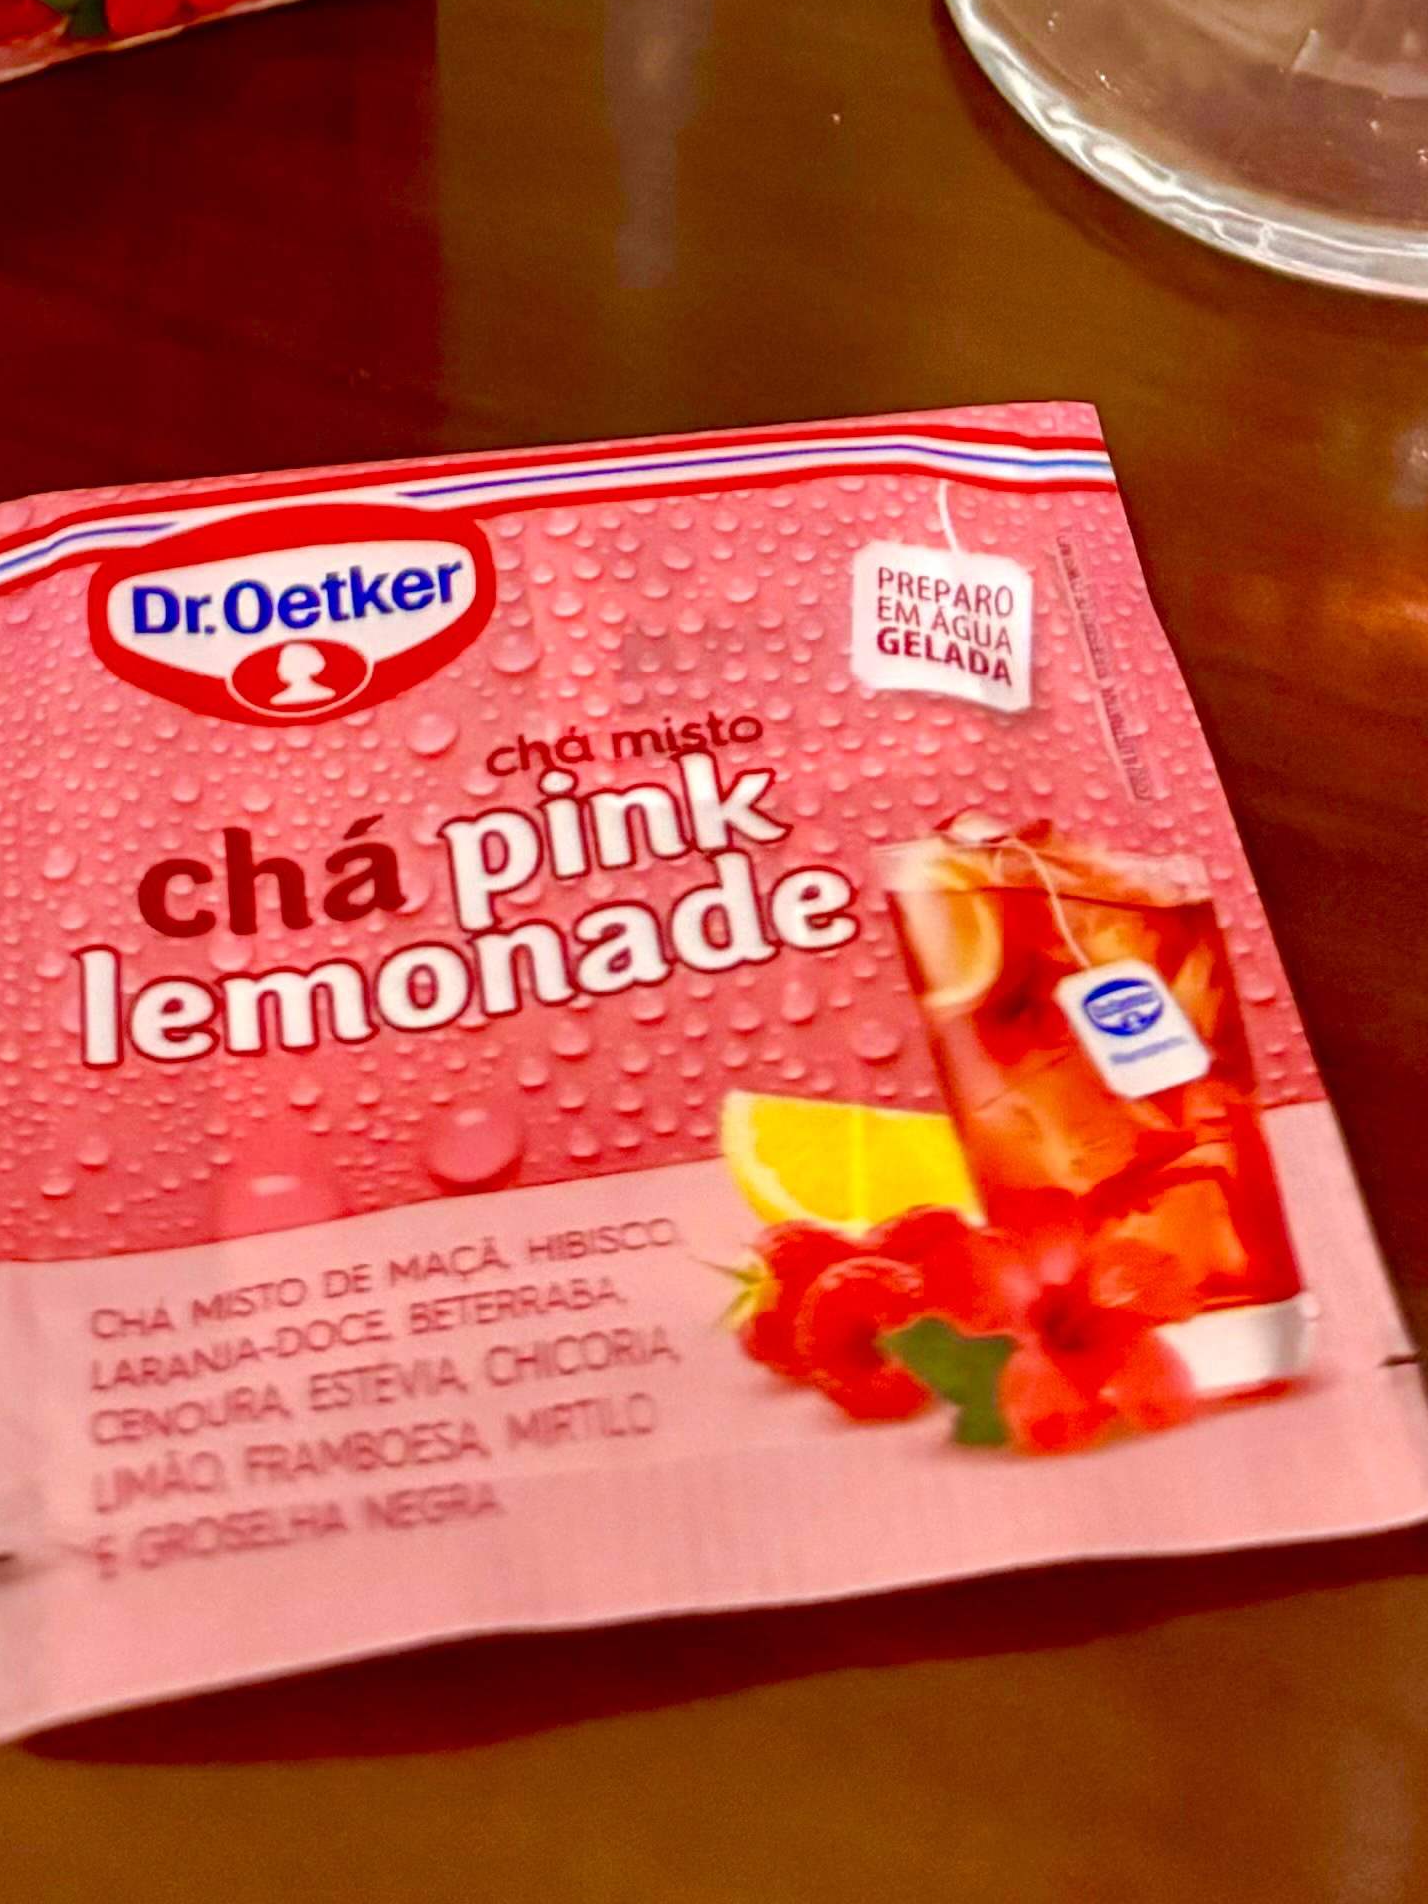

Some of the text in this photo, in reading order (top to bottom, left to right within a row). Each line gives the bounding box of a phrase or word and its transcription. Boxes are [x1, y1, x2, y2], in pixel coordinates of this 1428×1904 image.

[877, 565, 1014, 618] PREPARO
[877, 595, 1013, 656] EM ÁGUA
[876, 626, 1012, 688] GELADA
[485, 708, 765, 779] chá misto
[137, 747, 792, 939] chá pink
[70, 848, 861, 1070] lemonade
[90, 1296, 175, 1340] CHÁ
[191, 1277, 308, 1327] MISTO
[322, 1263, 373, 1300] DE
[506, 1391, 658, 1451] MIRTILO
[132, 1502, 349, 1572] GROSELHA
[363, 1482, 508, 1530] NEGRA
